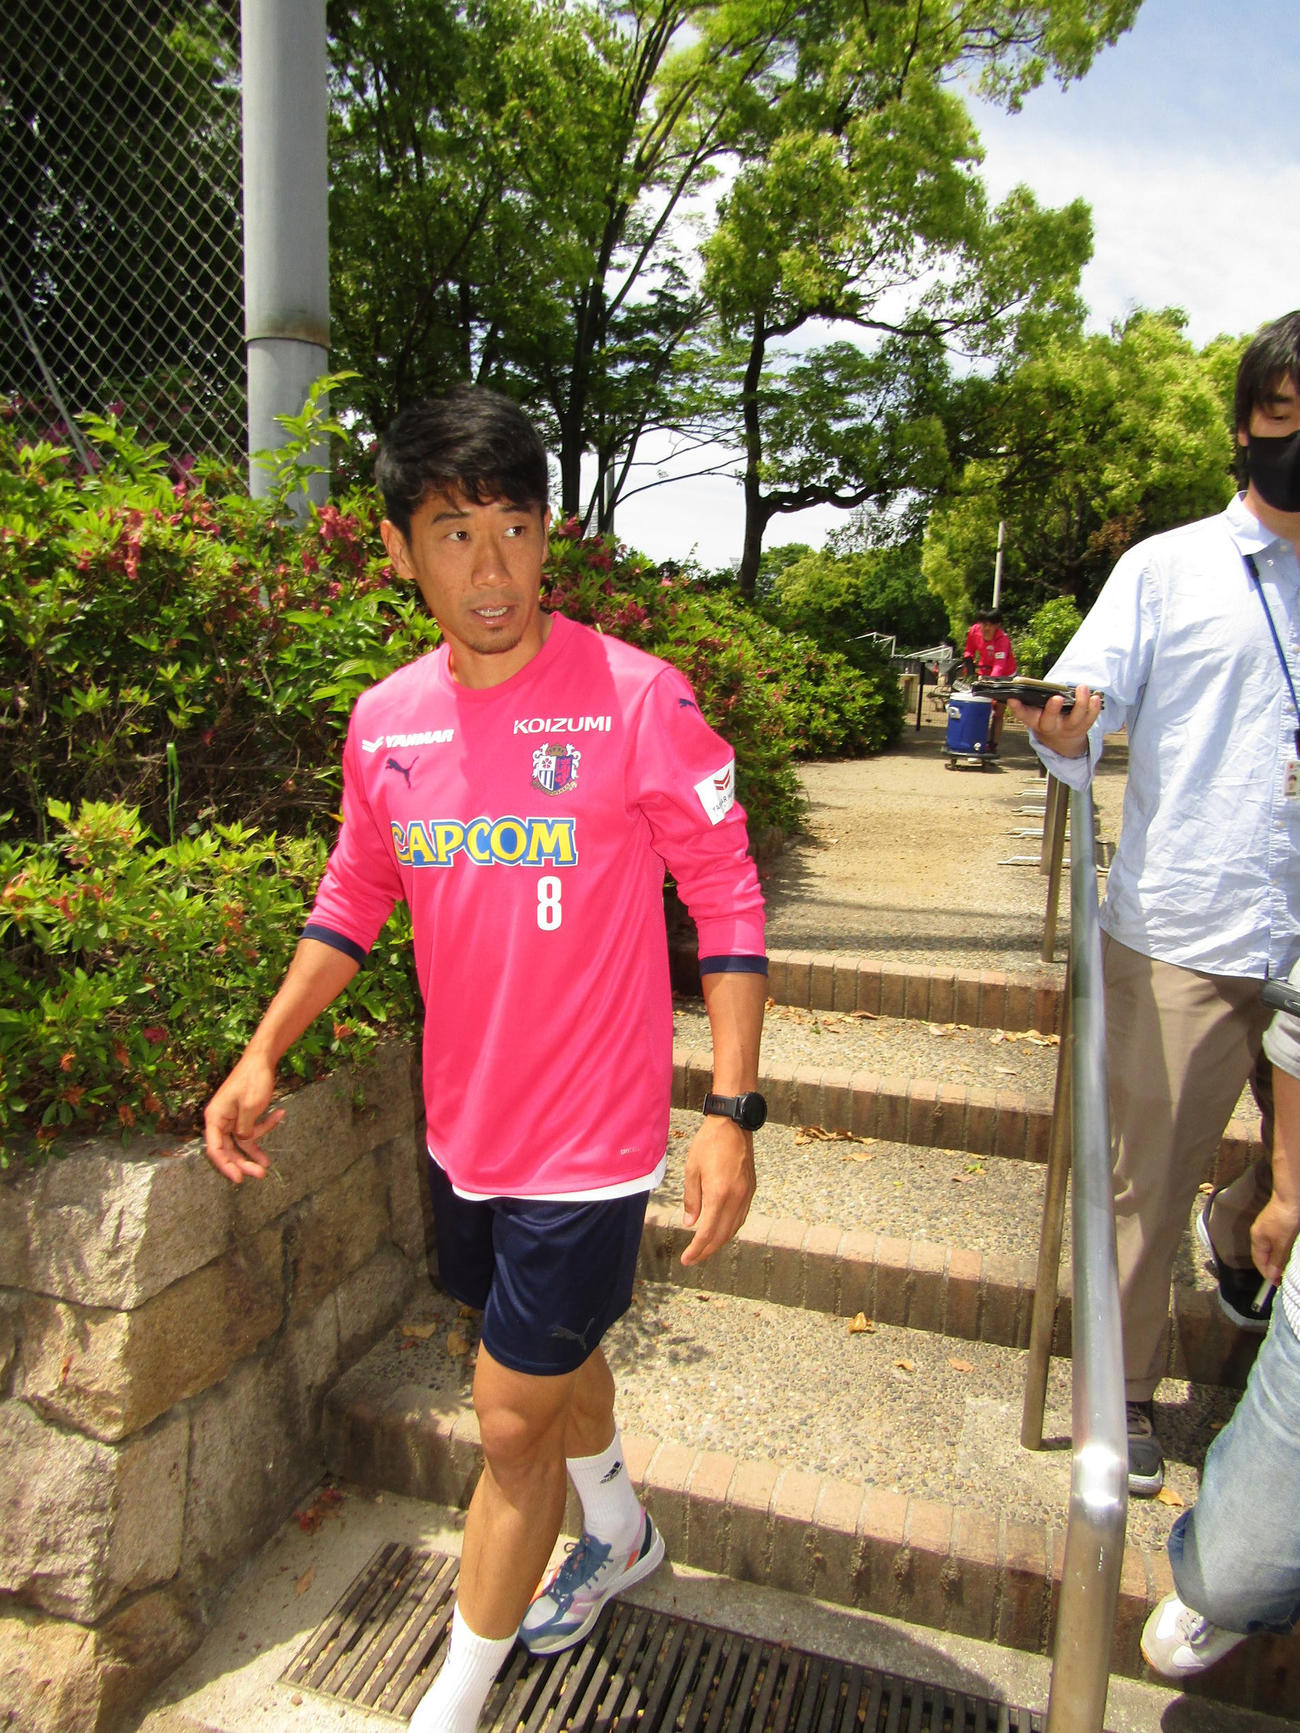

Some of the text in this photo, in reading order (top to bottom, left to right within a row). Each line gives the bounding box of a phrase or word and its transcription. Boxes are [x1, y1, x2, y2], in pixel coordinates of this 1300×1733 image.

[385, 729, 455, 748] YANMAR
[513, 716, 612, 734] KOIZUMI
[389, 815, 579, 868] CAPCOM
[537, 876, 562, 931] 8
